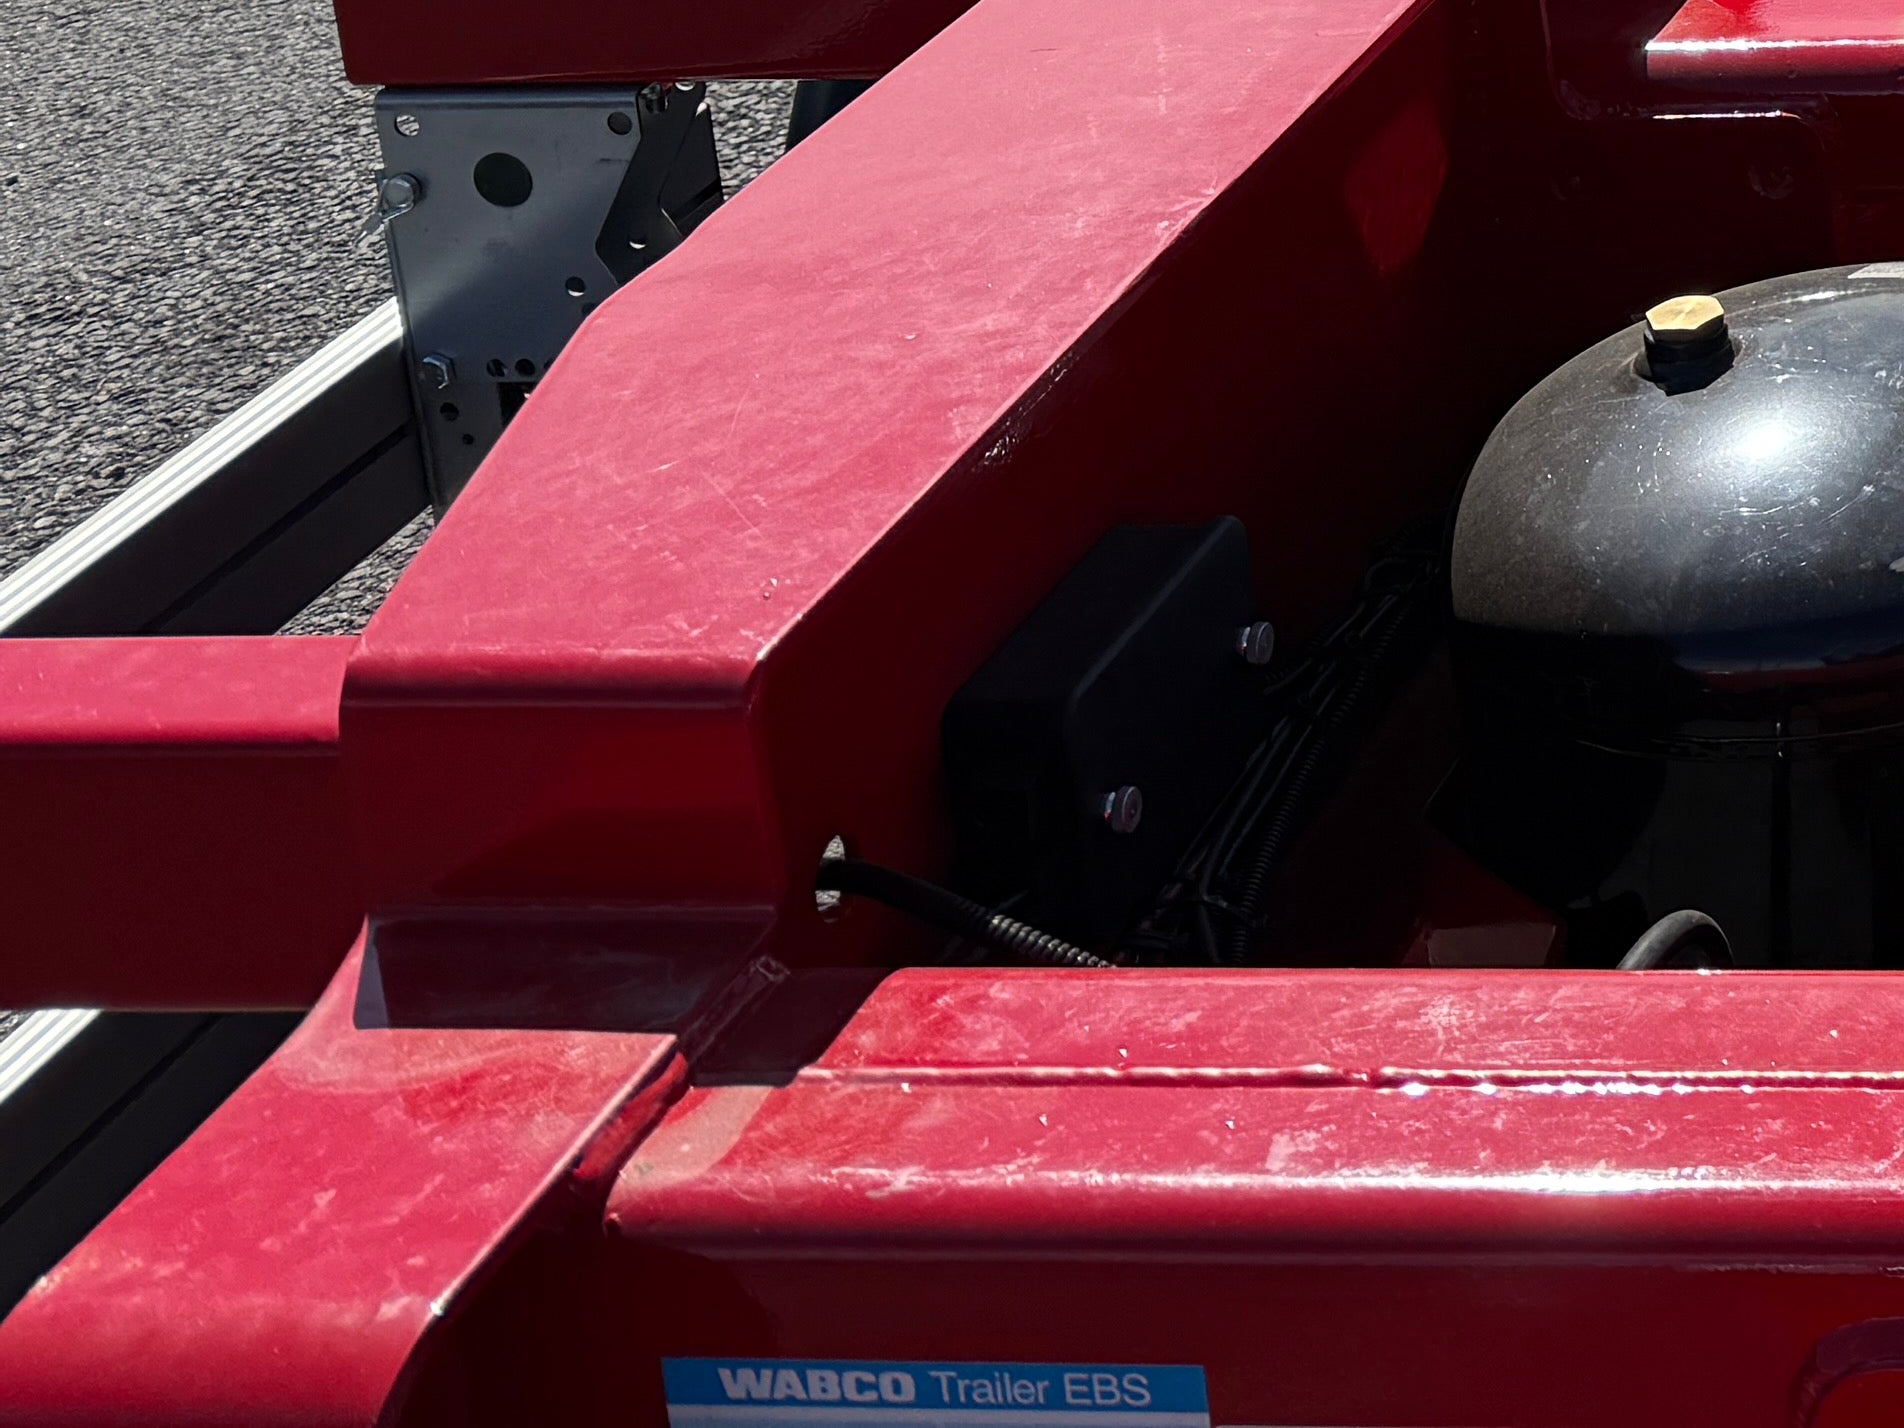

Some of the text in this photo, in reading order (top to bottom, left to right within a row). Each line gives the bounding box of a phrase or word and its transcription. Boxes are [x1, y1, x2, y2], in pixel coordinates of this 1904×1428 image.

[717, 1367, 1152, 1407] WABCO Trailer EBS
